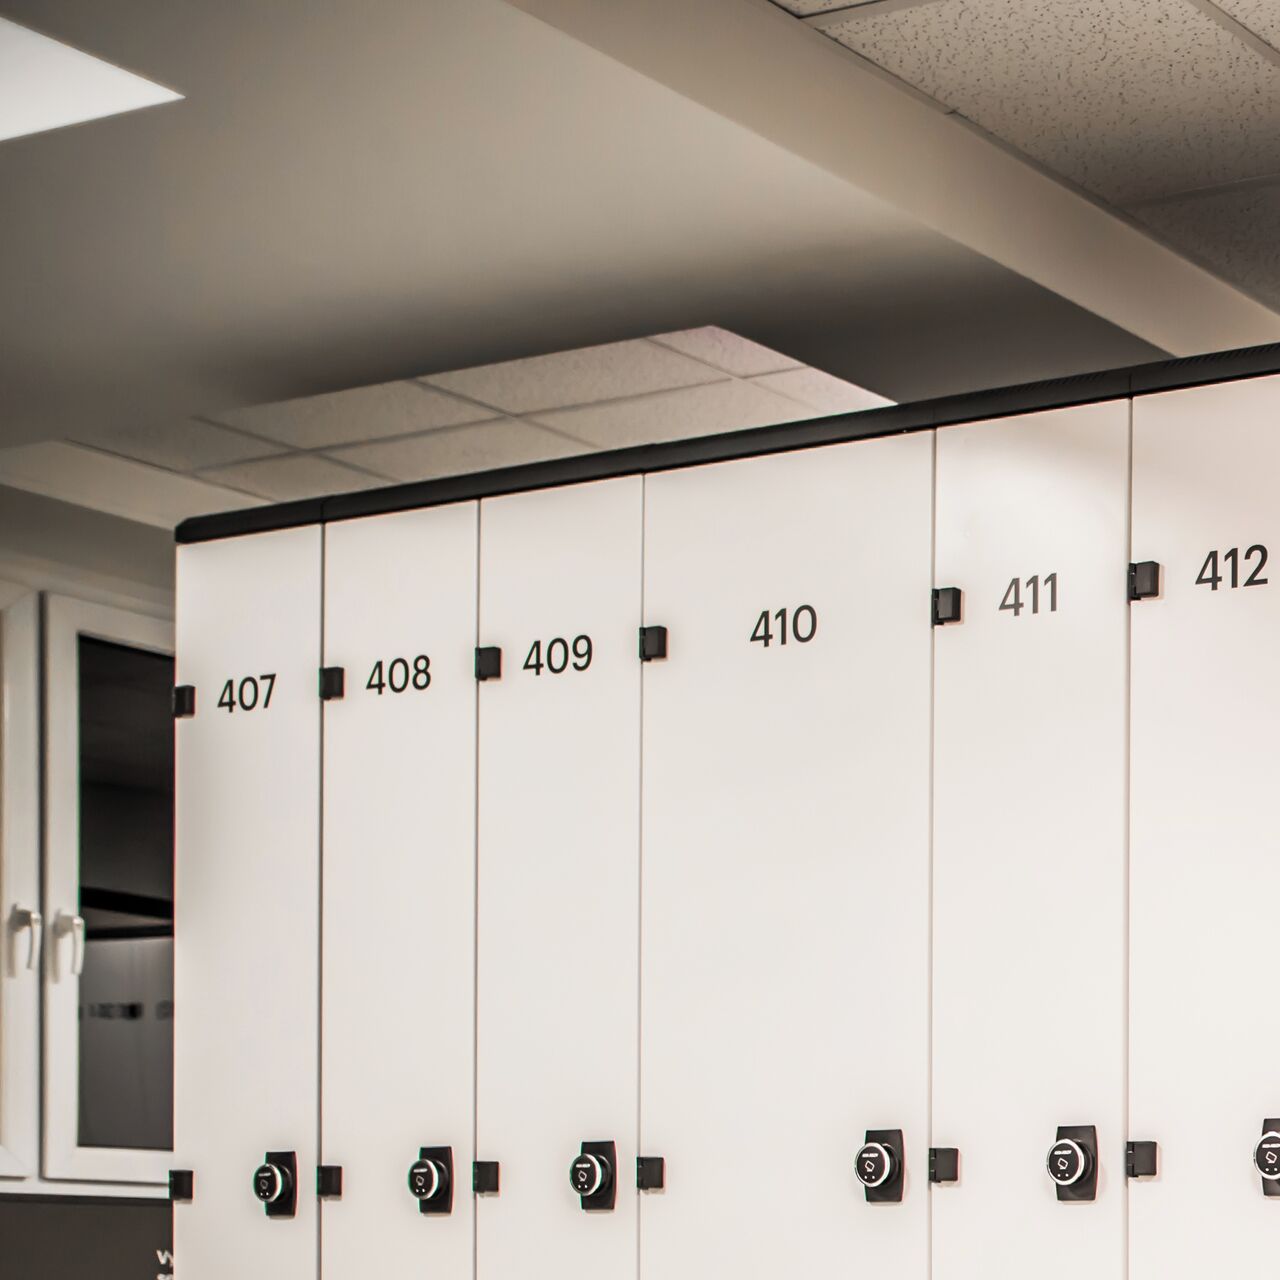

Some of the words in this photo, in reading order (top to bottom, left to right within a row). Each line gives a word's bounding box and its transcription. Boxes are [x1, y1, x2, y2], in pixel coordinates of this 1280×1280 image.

[1195, 545, 1269, 592] 412
[998, 572, 1058, 618] 411
[750, 604, 818, 649] 410
[366, 655, 432, 697] 408
[523, 635, 594, 678] 409
[217, 674, 277, 714] 407
